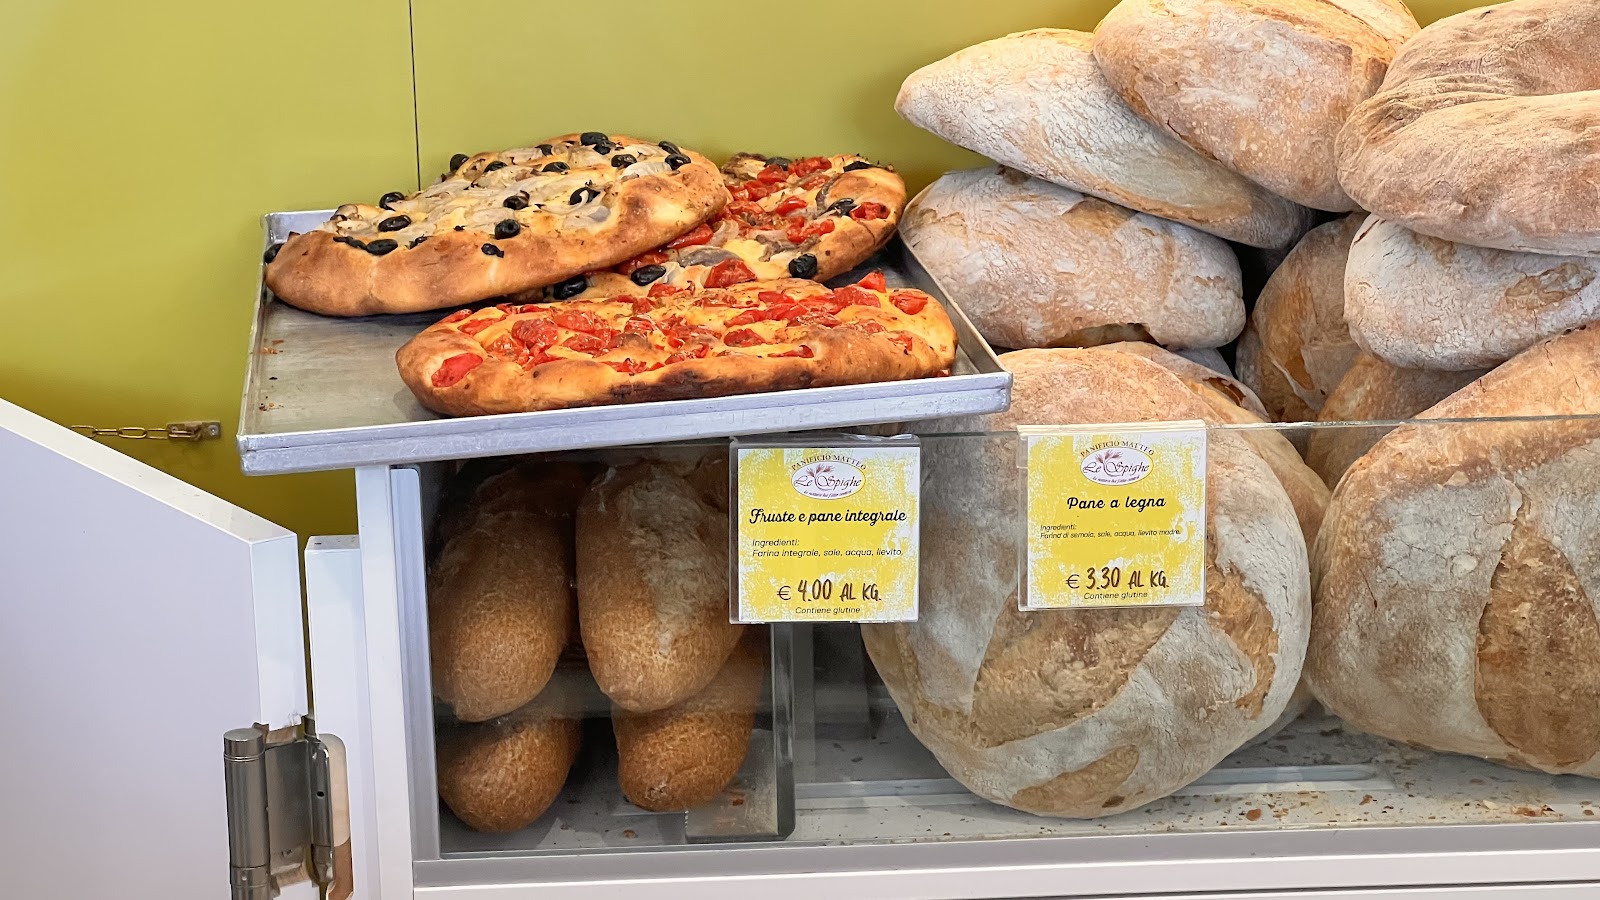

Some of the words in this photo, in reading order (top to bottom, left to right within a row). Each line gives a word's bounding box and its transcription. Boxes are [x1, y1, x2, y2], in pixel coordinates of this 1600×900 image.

[1080, 441, 1120, 457] PANIFICIO
[1122, 441, 1154, 455] MATTEO
[792, 455, 831, 471] PANIFICIO
[832, 455, 866, 470] MATTEO
[1083, 462, 1101, 473] Le
[1106, 462, 1149, 476] Spighe
[793, 475, 813, 487] Le
[817, 476, 861, 490] Spighe
[1067, 497, 1105, 509] Pane
[1110, 498, 1120, 507] a
[1126, 497, 1166, 512] legna
[750, 509, 797, 524] Fruste
[798, 514, 807, 522] e
[807, 513, 843, 525] pane
[845, 509, 907, 526] integrale
[1040, 524, 1076, 532] Ingredienti:
[752, 539, 800, 548] Ingredienti:
[782, 549, 820, 558] integrale,
[823, 549, 843, 557] sale,
[1065, 574, 1080, 589] €
[1086, 567, 1120, 590] 3.30
[1128, 571, 1144, 589] AL
[1150, 571, 1169, 588] KG.
[777, 586, 791, 601] €
[797, 579, 832, 602] 4.00
[840, 584, 856, 602] AL
[862, 584, 882, 601] KG.
[1084, 592, 1120, 600] Contiene
[1121, 591, 1147, 599] glutine
[833, 607, 860, 616] glutine
